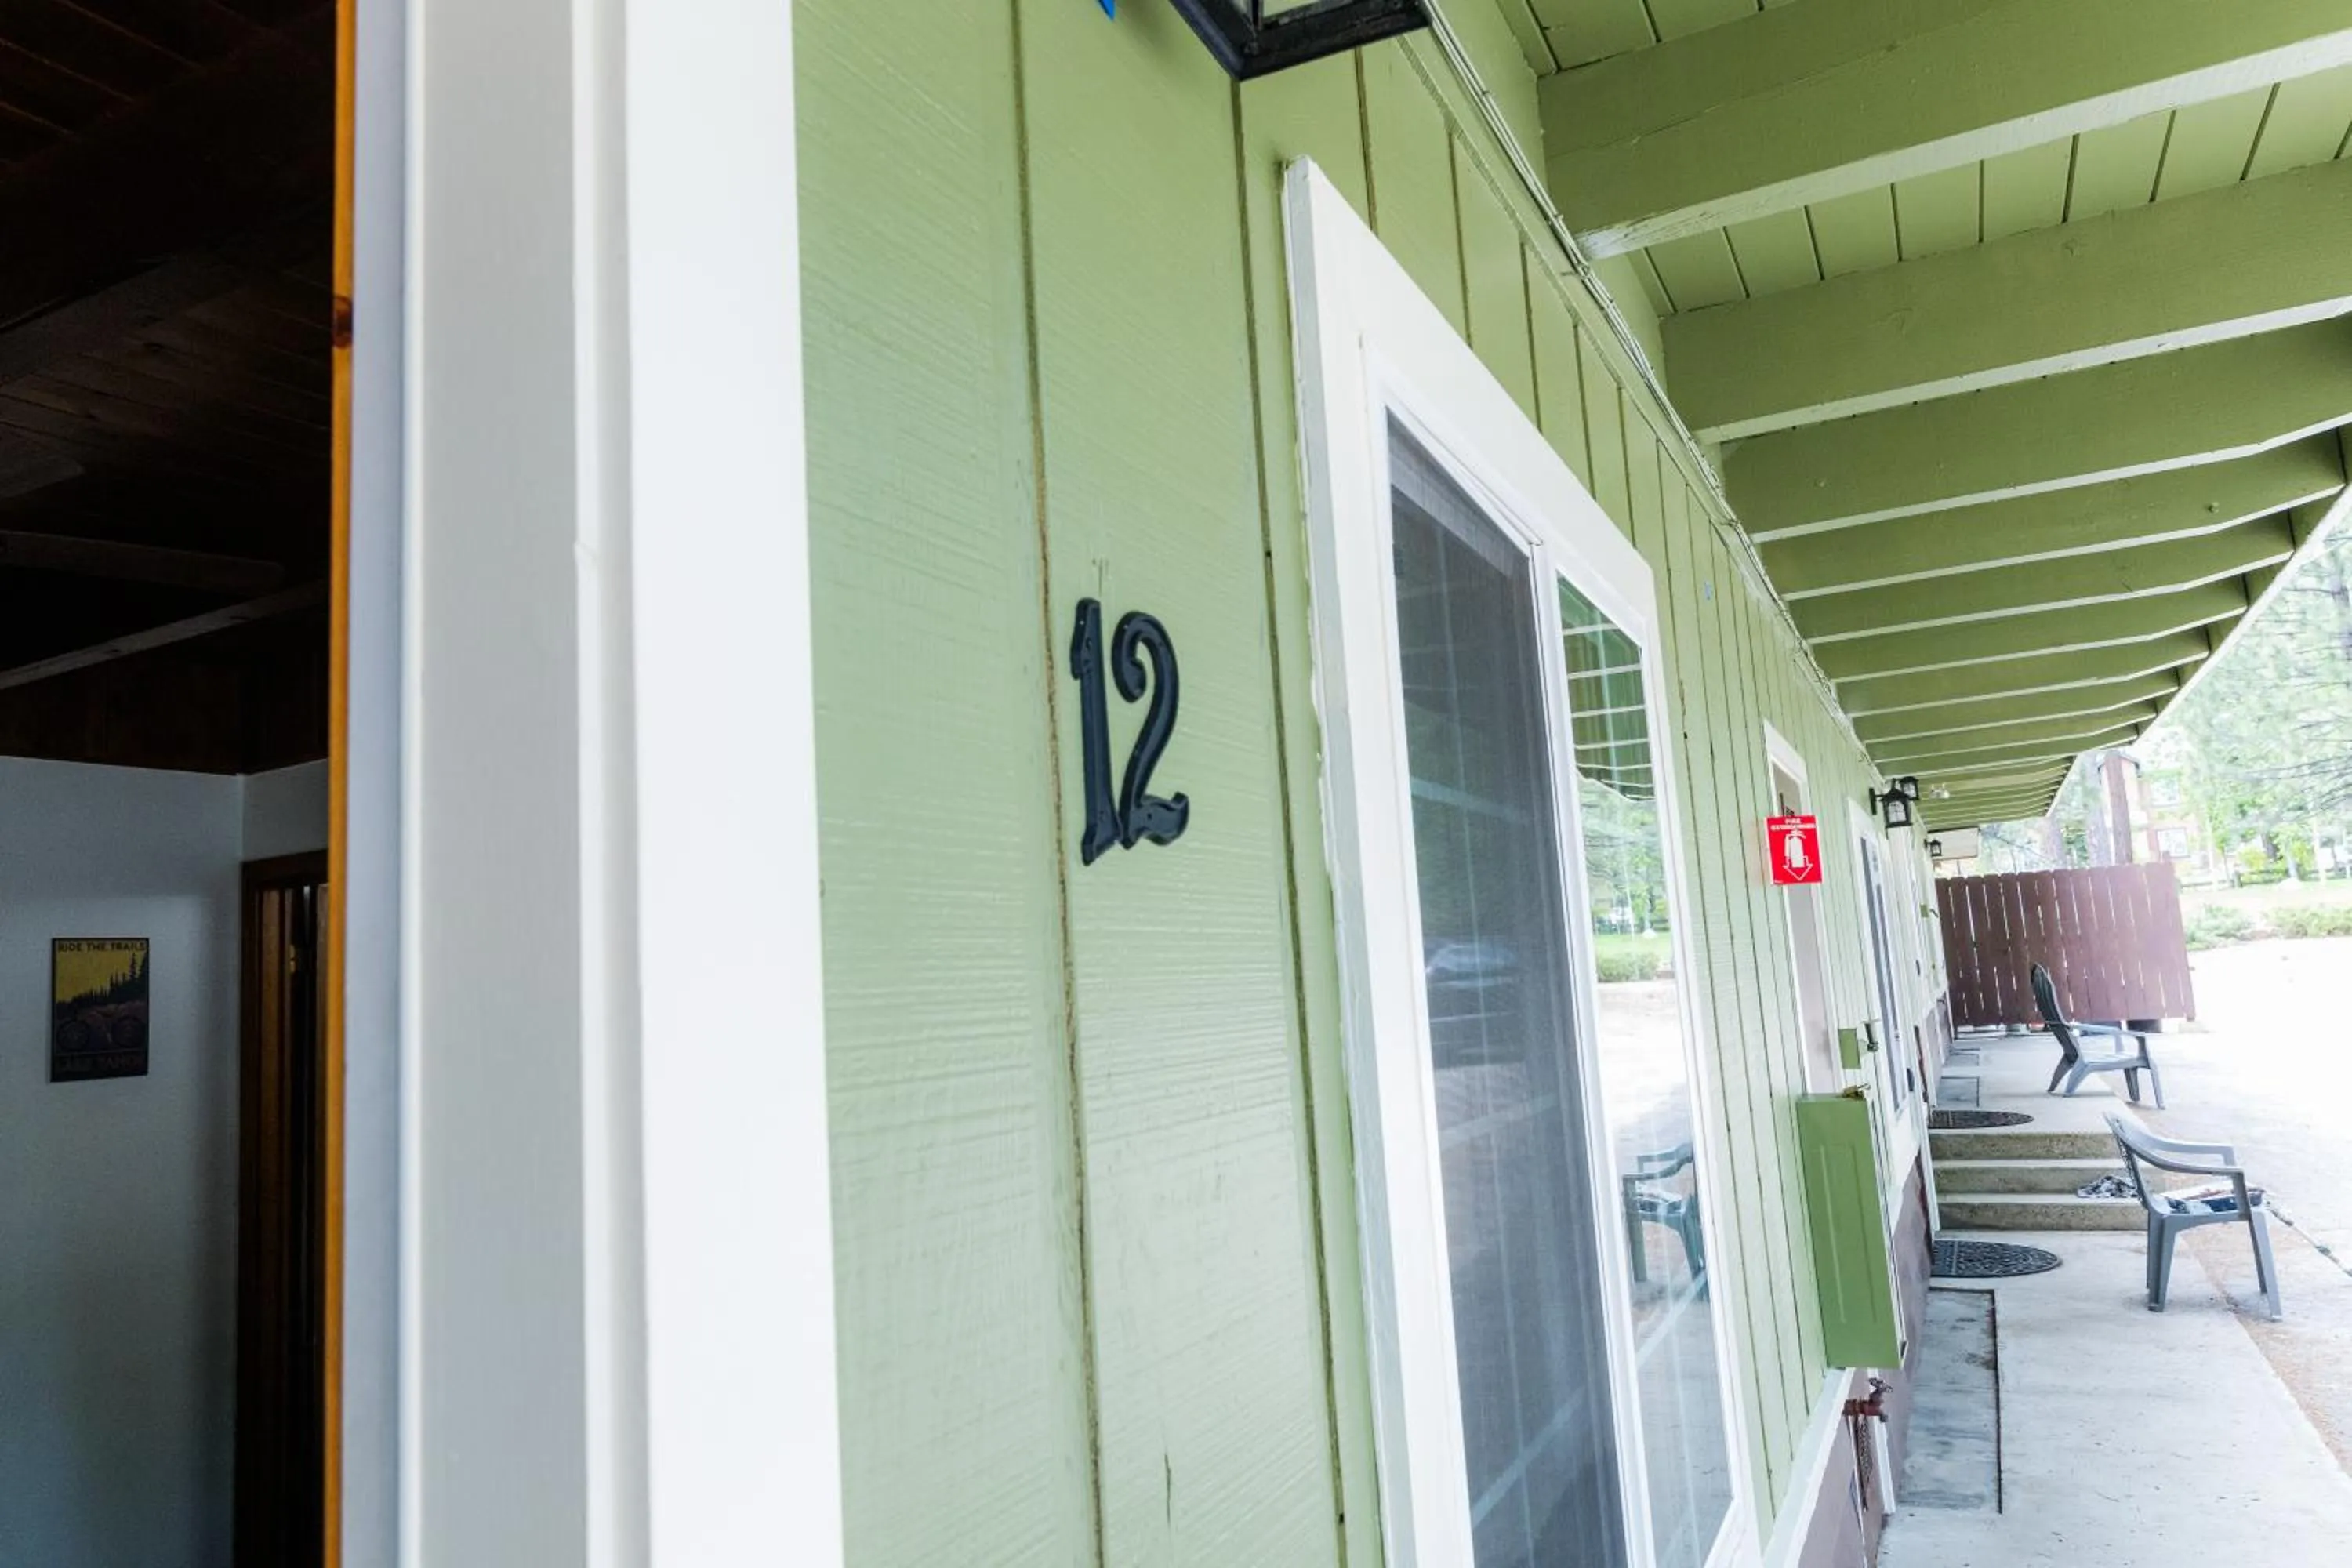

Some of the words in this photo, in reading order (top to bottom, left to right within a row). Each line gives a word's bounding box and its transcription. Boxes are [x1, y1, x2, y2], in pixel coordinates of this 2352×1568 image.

[1070, 597, 1189, 866] 12
[58, 942, 82, 952] RIDE
[86, 942, 107, 951] THE
[111, 942, 146, 951] TRAILS
